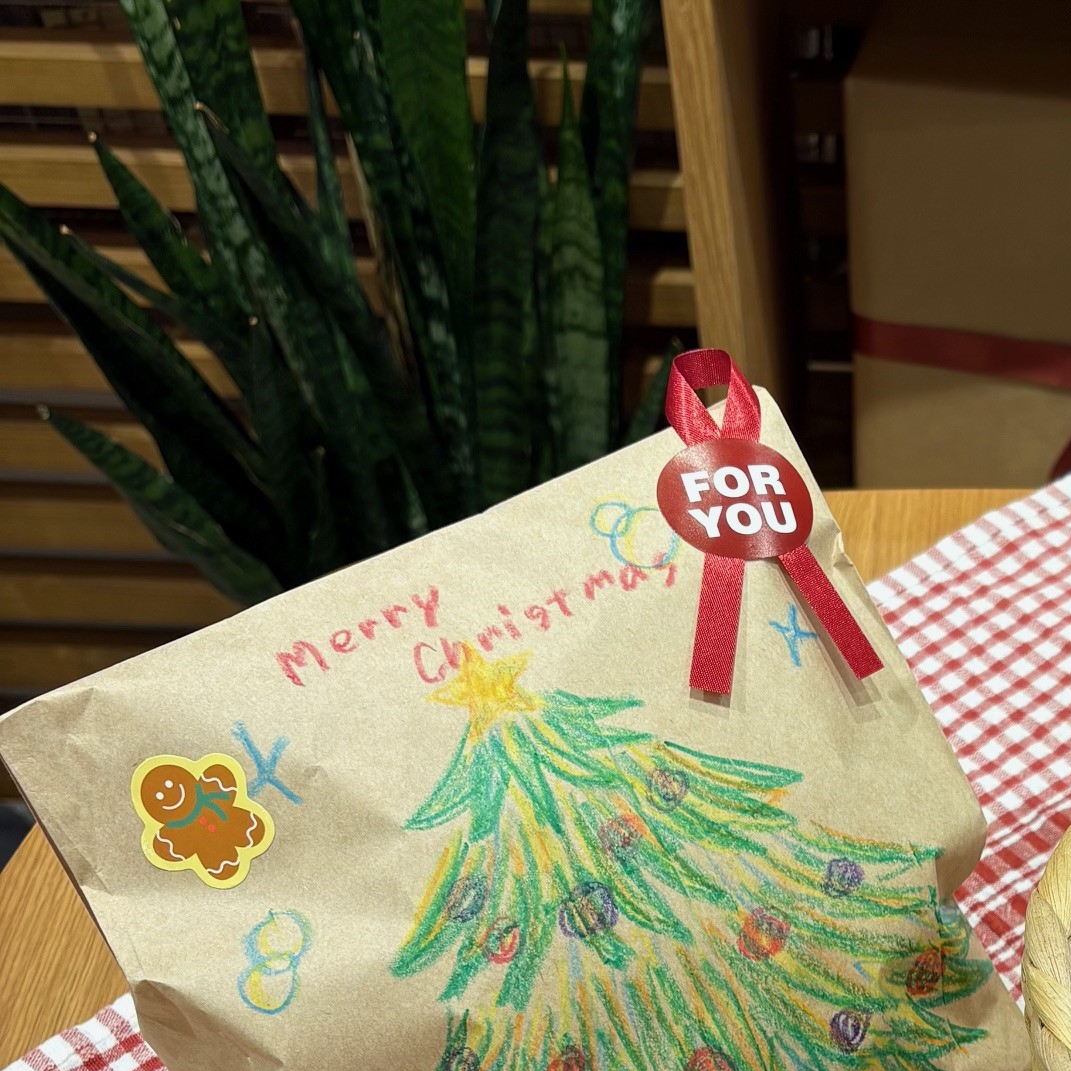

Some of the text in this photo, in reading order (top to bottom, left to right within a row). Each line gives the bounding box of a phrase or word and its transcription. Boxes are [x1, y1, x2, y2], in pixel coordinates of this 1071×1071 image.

[680, 464, 787, 503] FOR
[687, 501, 798, 539] YOU
[275, 584, 439, 687] Merry
